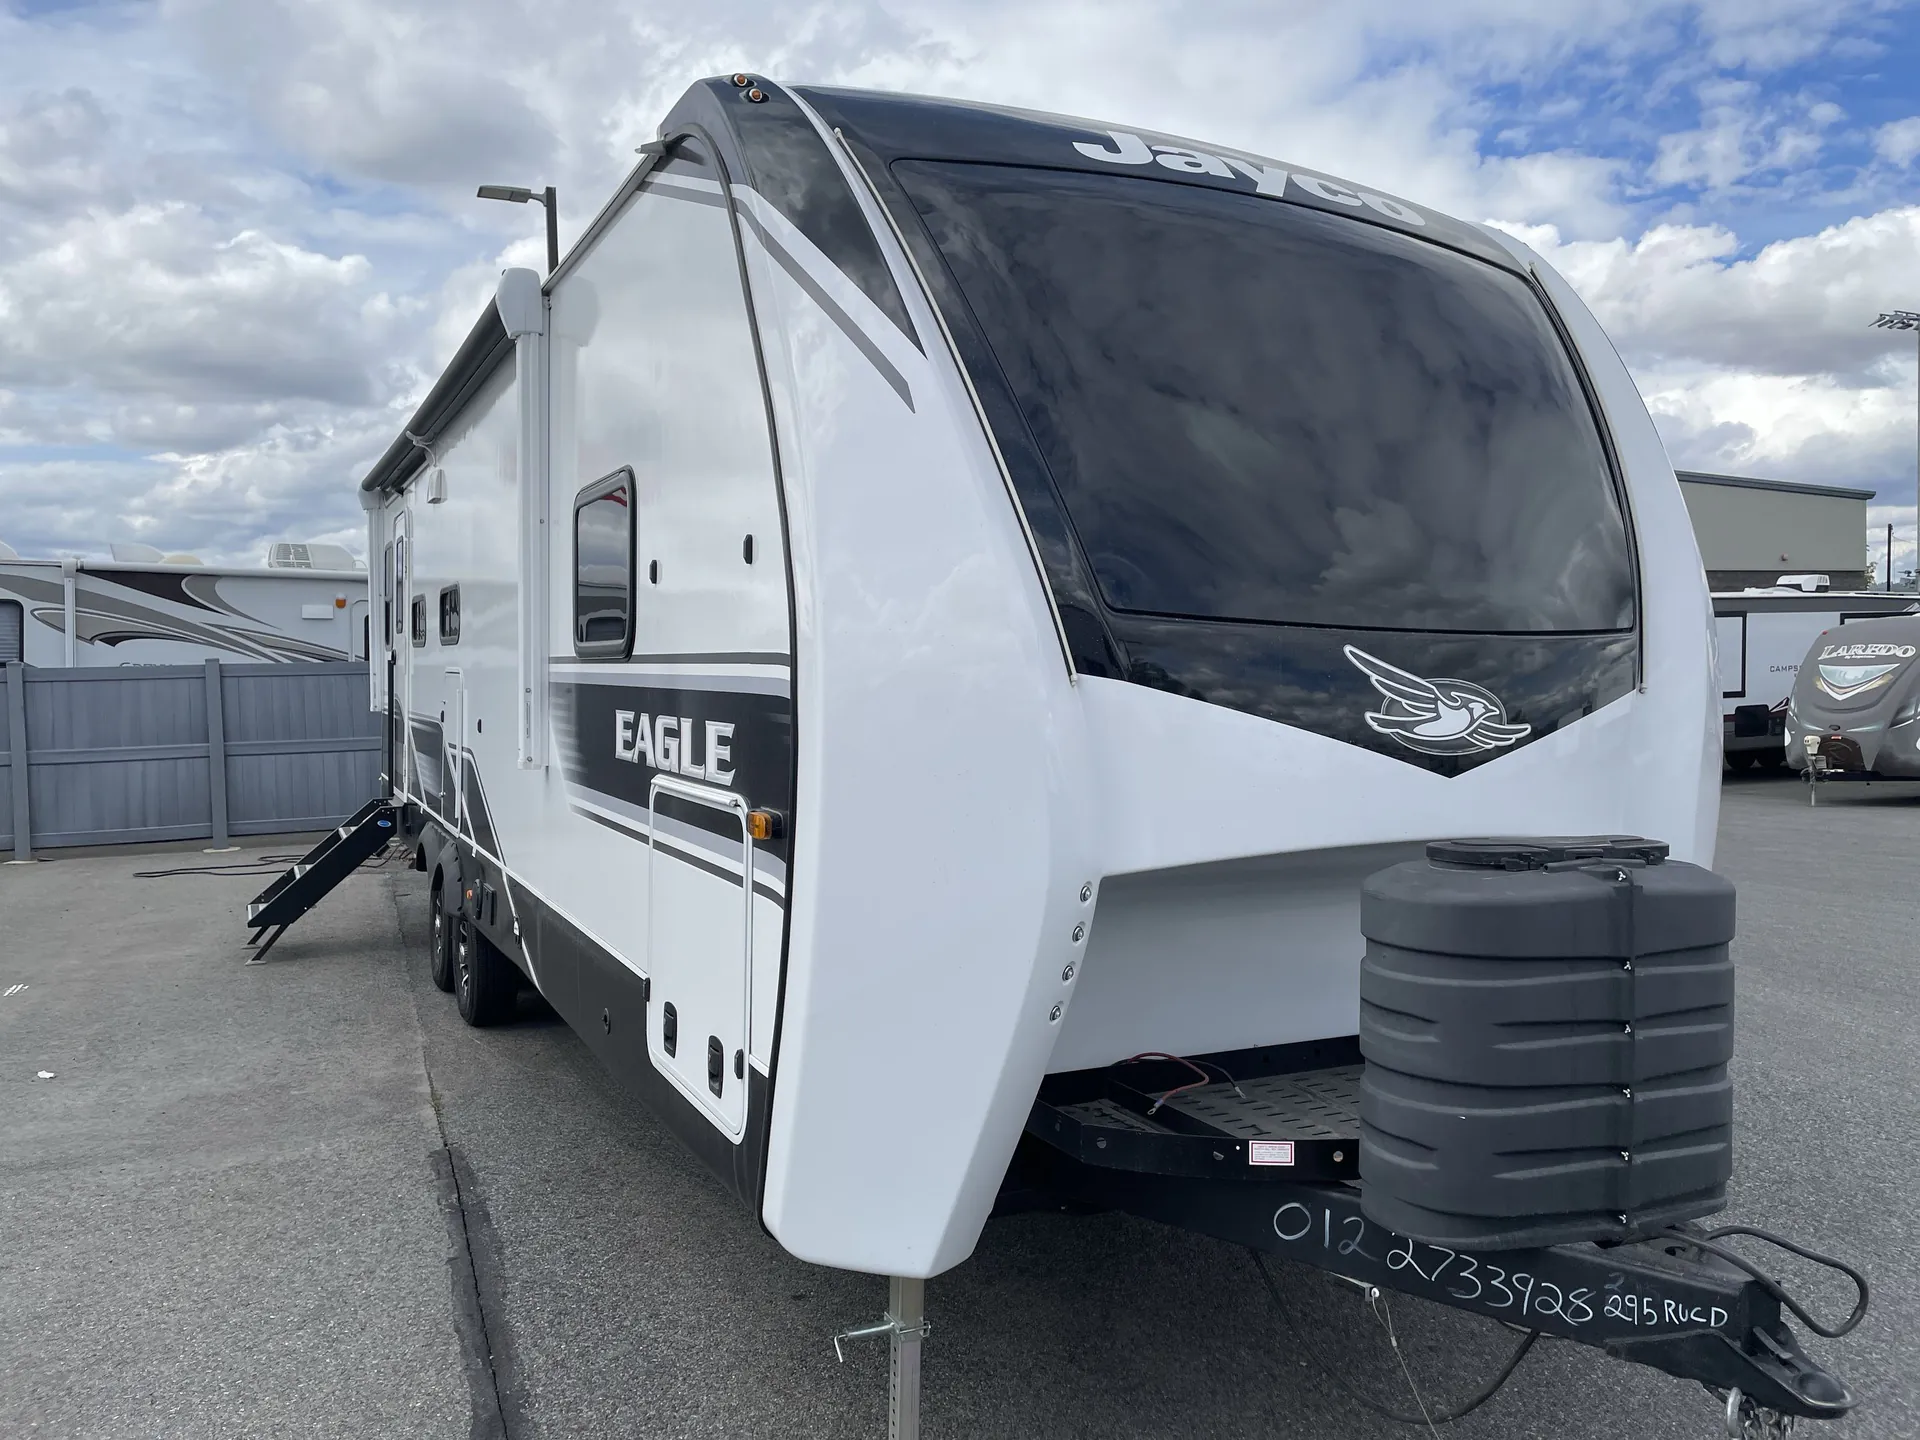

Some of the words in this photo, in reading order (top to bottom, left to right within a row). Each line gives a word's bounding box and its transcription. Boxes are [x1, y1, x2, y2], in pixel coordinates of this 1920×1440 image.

[1072, 130, 1426, 226] Jayco
[1817, 643, 1916, 660] LAREDO
[614, 709, 737, 787] EAGLE
